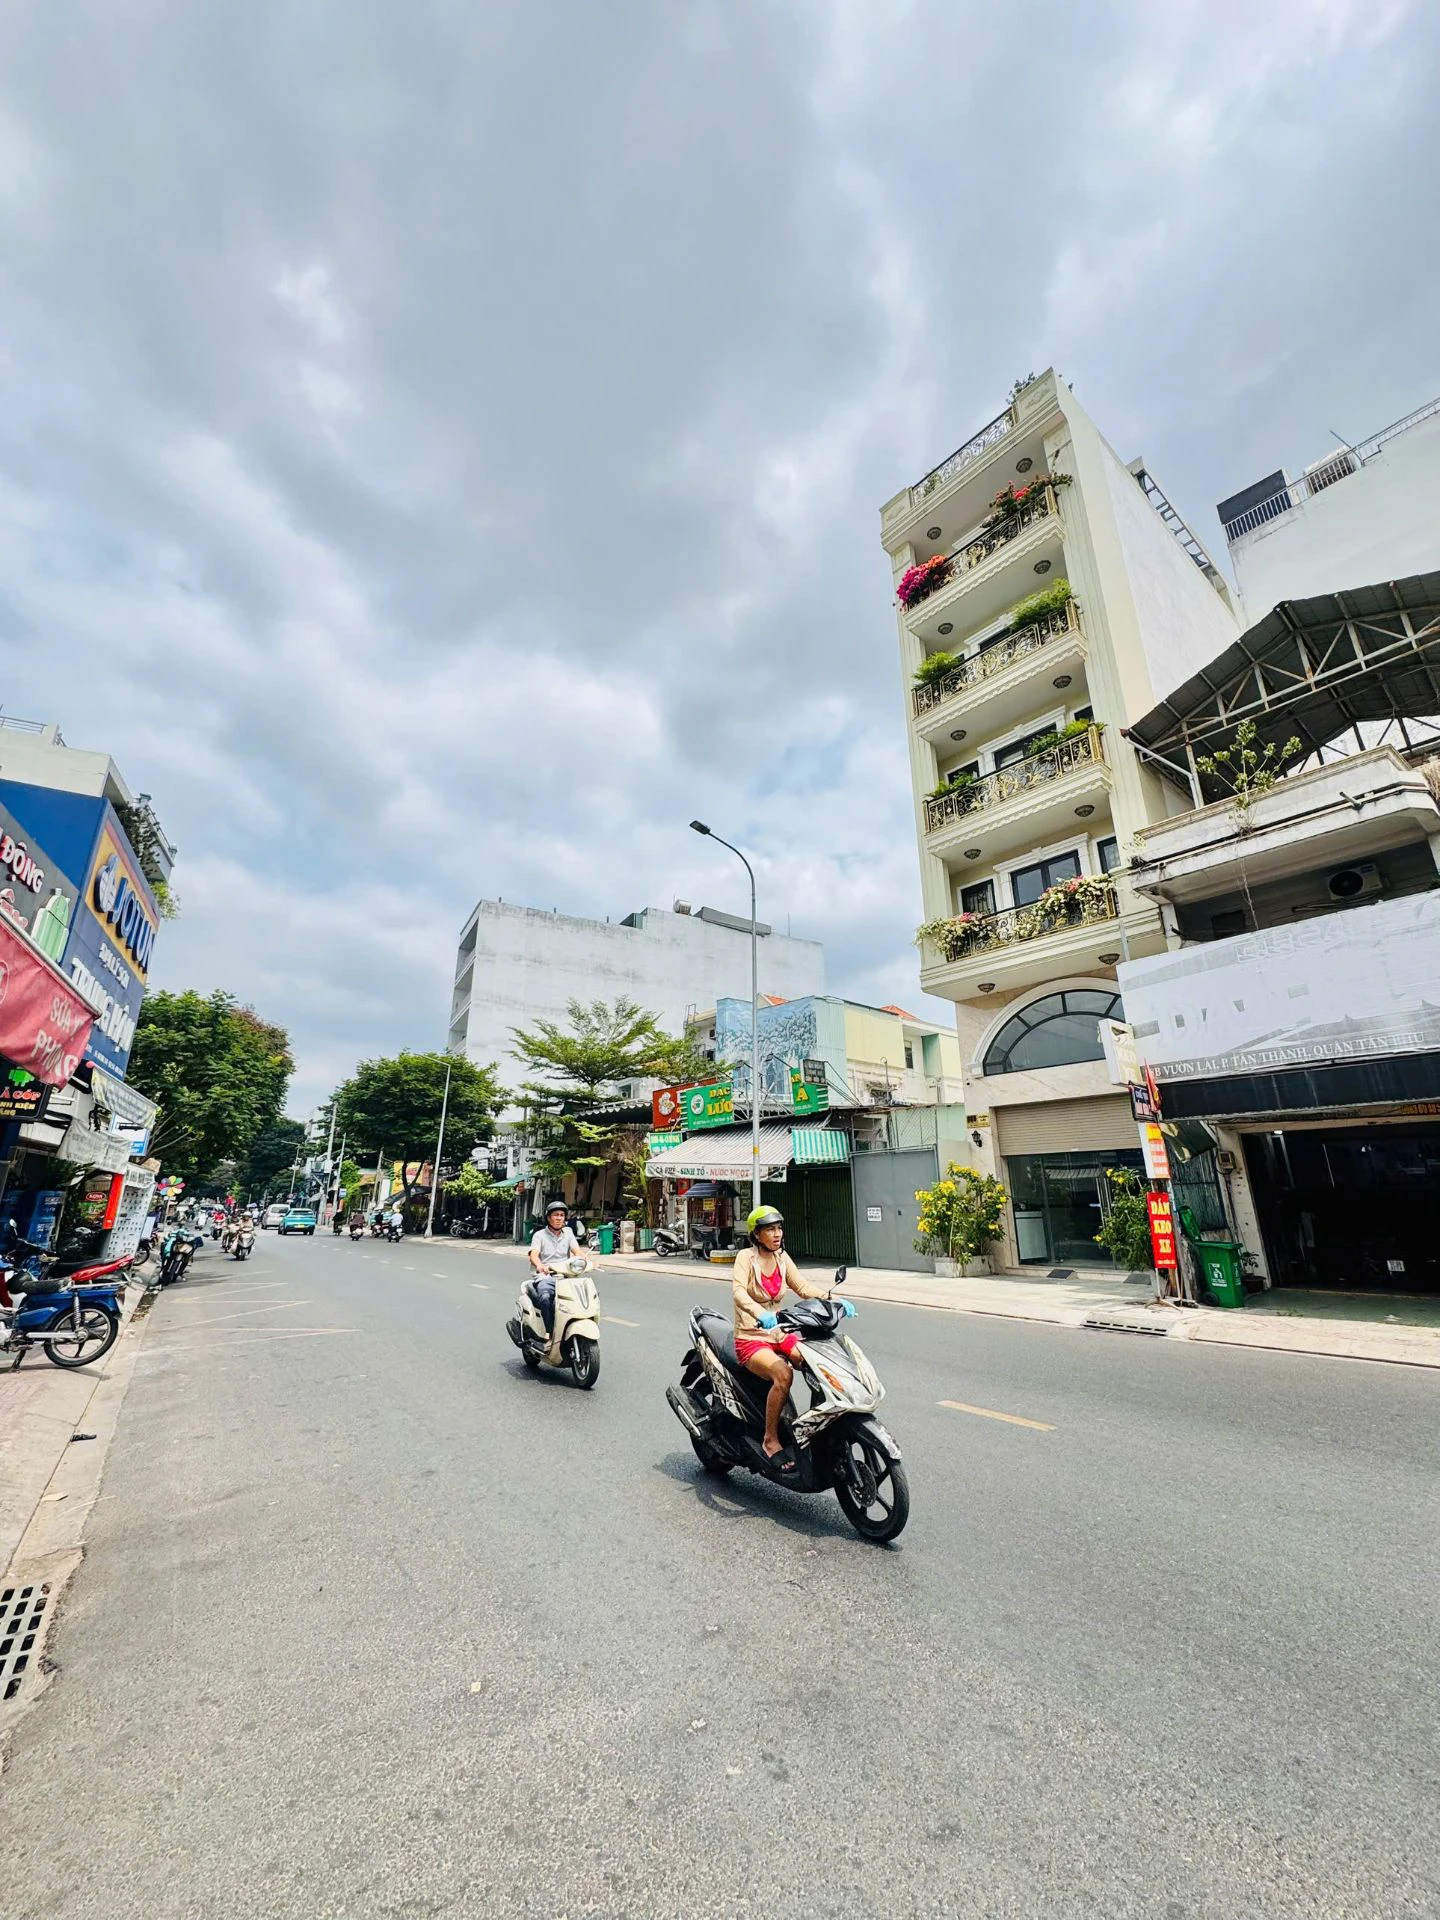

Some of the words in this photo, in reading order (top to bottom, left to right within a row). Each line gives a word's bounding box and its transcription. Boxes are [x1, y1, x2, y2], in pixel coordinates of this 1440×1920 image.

[1, 835, 44, 893] ĐỘNG
[112, 877, 155, 972] JOTUN
[72, 957, 113, 1033] TRUNG
[709, 1086, 731, 1098] ĐẶC
[1151, 1198, 1171, 1215] DÁN
